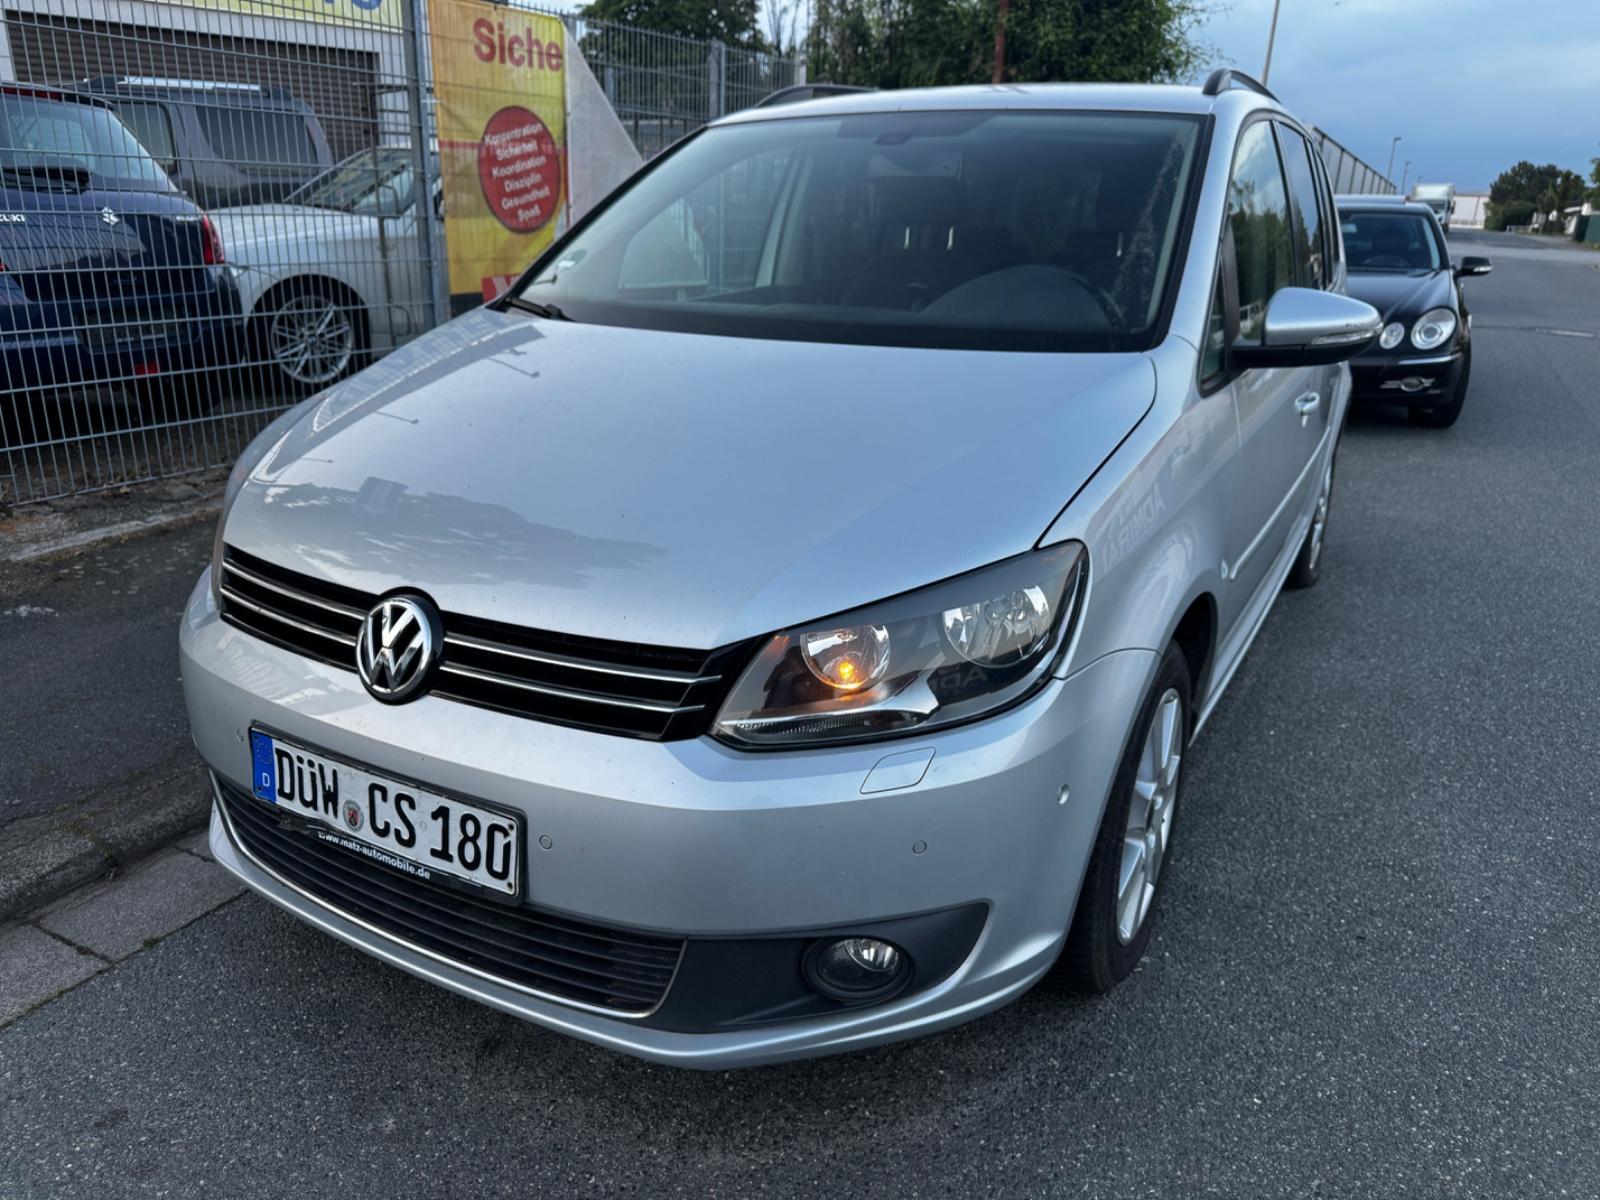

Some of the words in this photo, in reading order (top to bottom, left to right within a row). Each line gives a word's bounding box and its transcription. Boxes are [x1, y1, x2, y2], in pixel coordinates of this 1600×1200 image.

[473, 17, 563, 72] Siche
[483, 122, 544, 145] Konzentration
[495, 140, 538, 161] Sicherheit
[492, 155, 546, 179] Koordination
[504, 173, 542, 192] Disziplin
[501, 186, 551, 210] Gesundheit
[517, 204, 541, 222] Spaß
[262, 772, 270, 787] D
[368, 782, 417, 848] CS
[430, 805, 512, 881] 180
